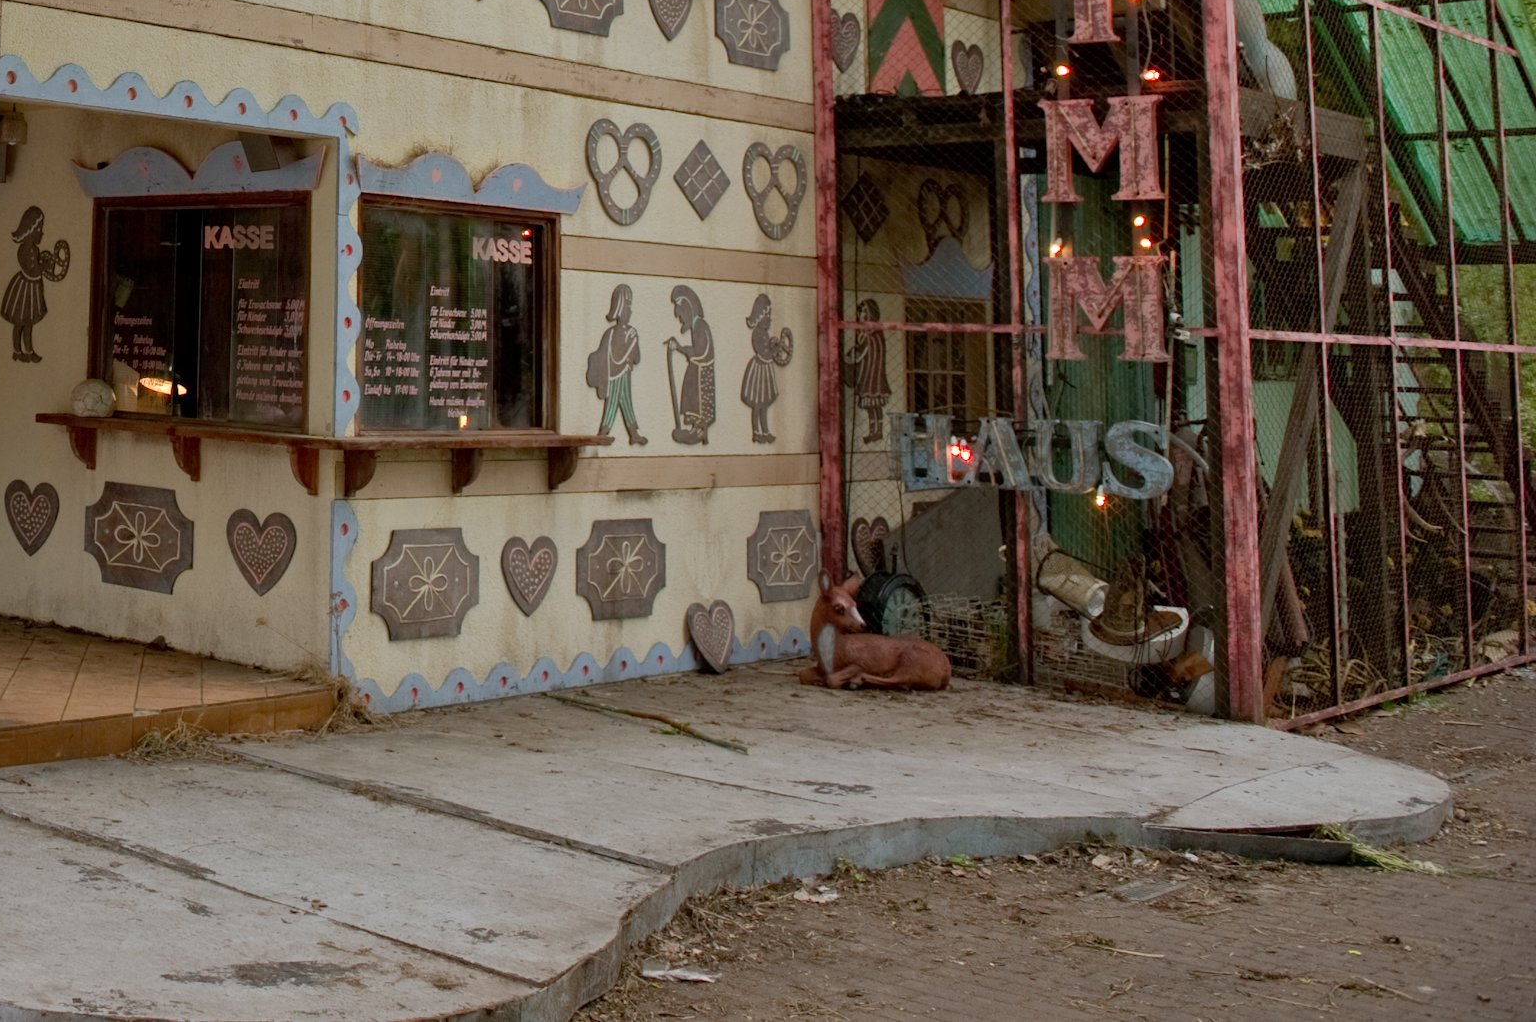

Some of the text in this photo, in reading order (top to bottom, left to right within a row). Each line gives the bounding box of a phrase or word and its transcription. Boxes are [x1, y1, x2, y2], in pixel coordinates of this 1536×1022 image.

[204, 224, 274, 249] KASSE
[472, 237, 532, 265] KASSE
[886, 412, 1174, 500] HAUS
